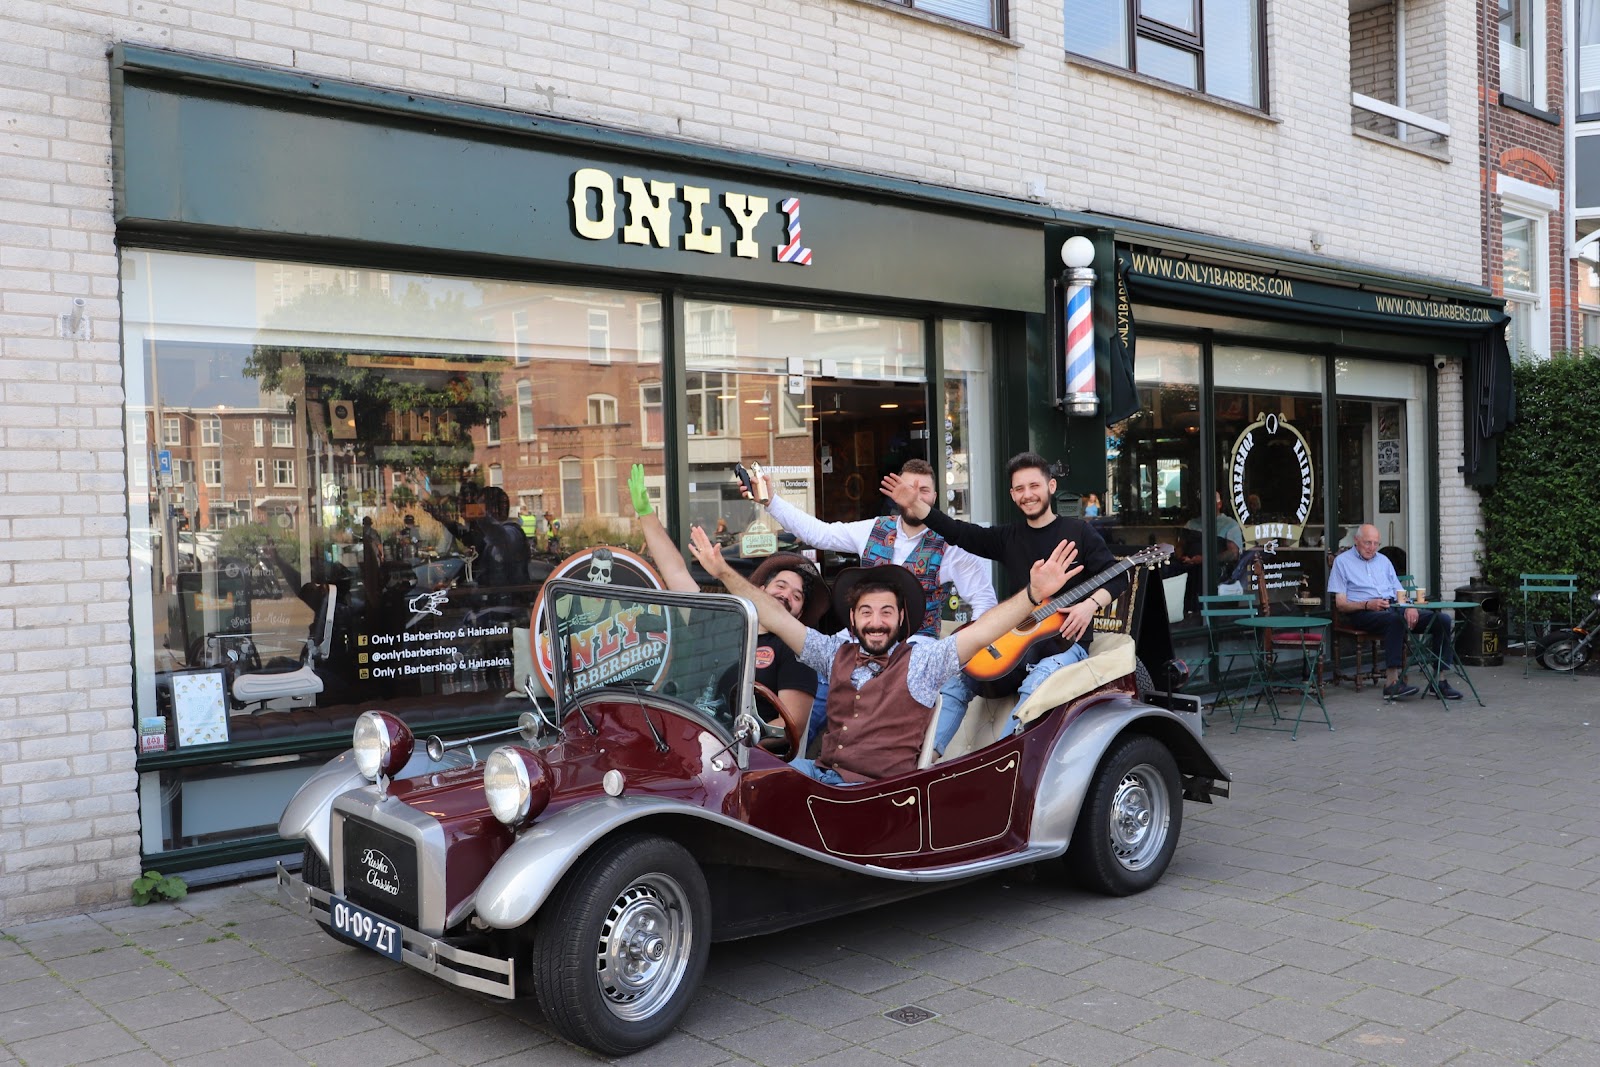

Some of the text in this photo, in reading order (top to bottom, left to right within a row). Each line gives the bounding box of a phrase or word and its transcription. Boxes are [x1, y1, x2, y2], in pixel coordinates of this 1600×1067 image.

[1131, 252, 1294, 298] WWW.ONLY1BARBERS.COM
[1375, 295, 1493, 323] WWW.ONLY1BARBERS.COM
[1233, 432, 1255, 525] BARBERSHOP
[1293, 438, 1311, 523] HAIRSALON
[1255, 523, 1293, 540] ONLY 1
[371, 625, 509, 646] Only 1 Barbershop & Hairsalon
[371, 646, 458, 662] @only1barbershop
[372, 656, 510, 678] Only 1 Barbershop & Hairsalon
[334, 903, 396, 954] 01-09-ZT
